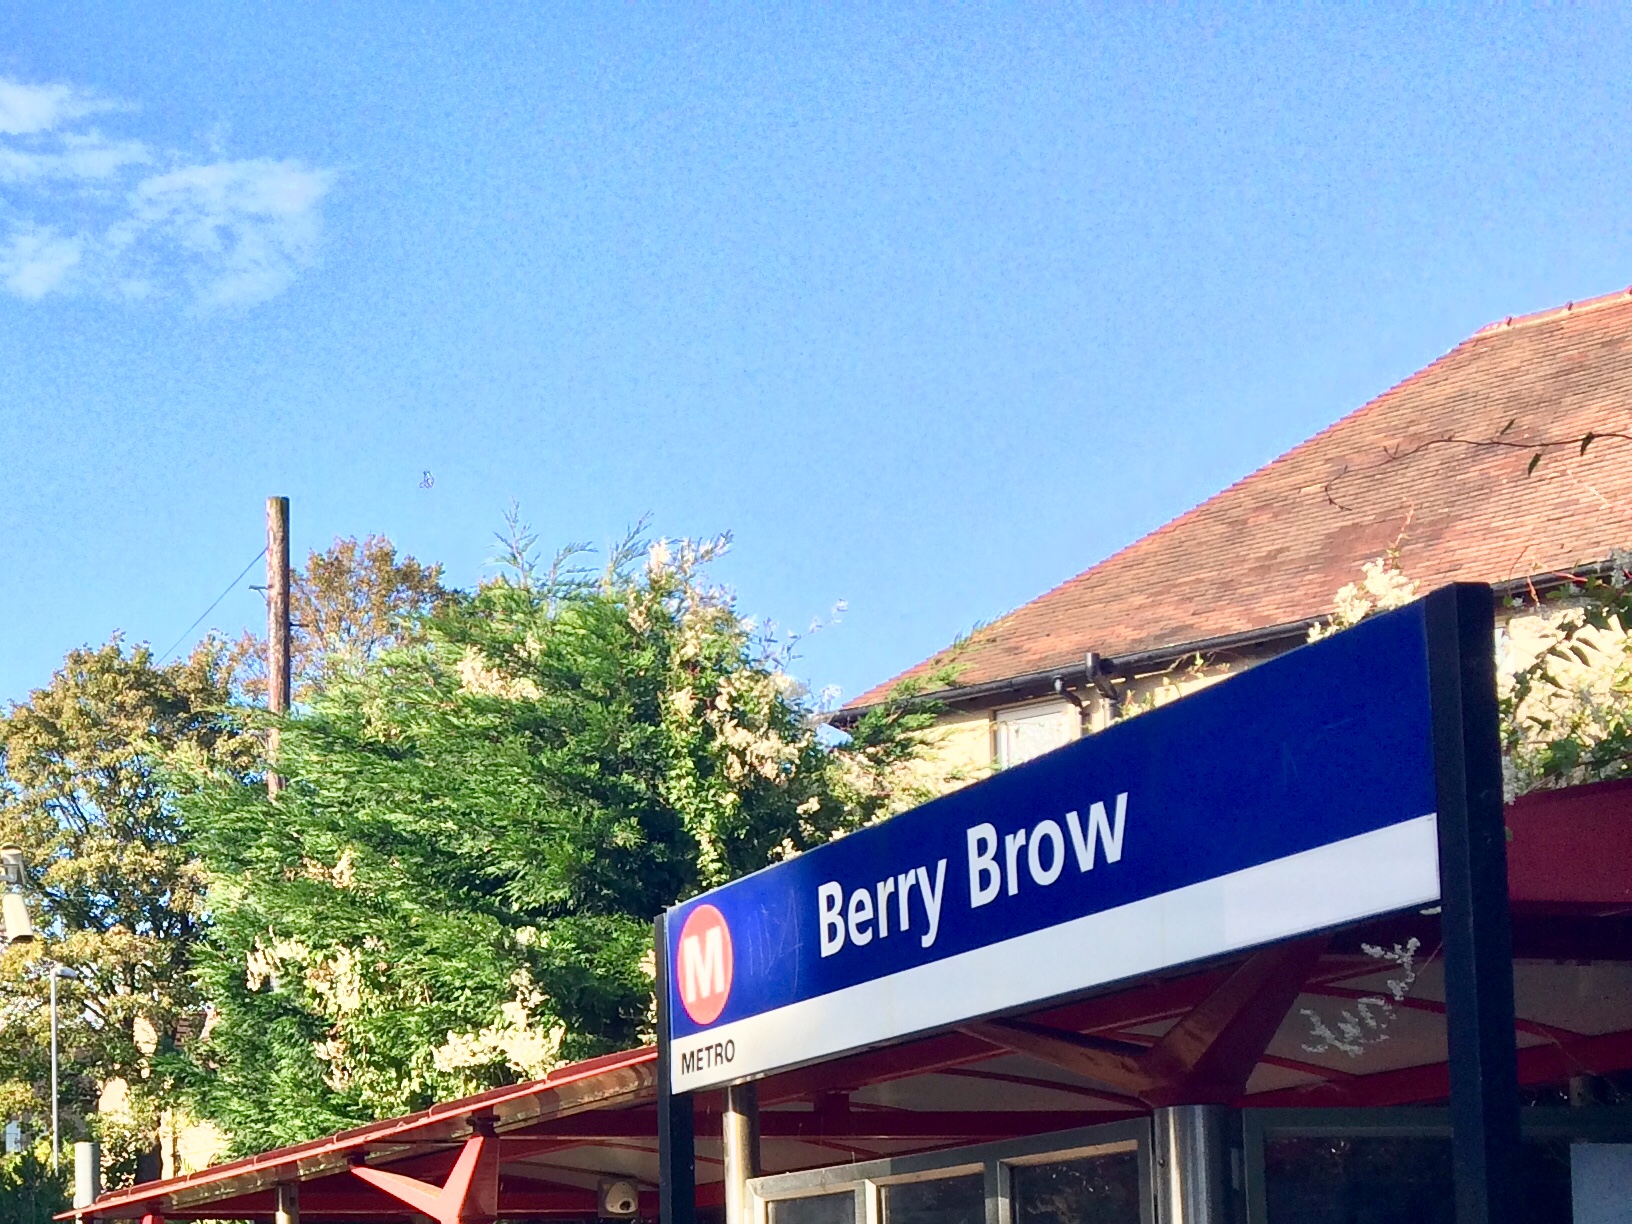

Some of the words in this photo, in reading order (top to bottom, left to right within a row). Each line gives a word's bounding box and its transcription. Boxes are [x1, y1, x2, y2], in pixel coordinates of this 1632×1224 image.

[818, 858, 948, 958] Berry
[966, 792, 1129, 909] Brow
[683, 925, 726, 1004] M
[681, 1038, 736, 1075] METRO
